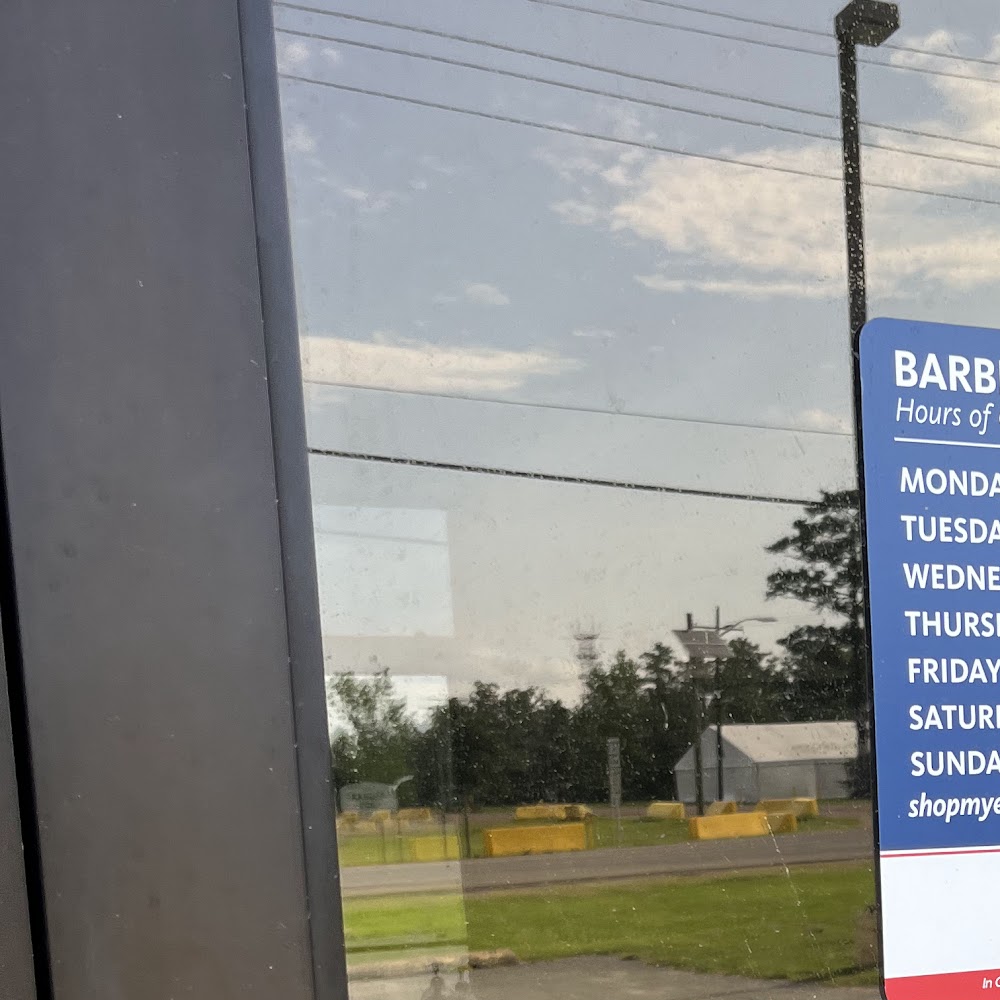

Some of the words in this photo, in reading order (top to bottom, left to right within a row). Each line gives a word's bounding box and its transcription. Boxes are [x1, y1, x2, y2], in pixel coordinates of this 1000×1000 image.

[896, 397, 961, 427] Hours
[969, 403, 994, 435] of
[982, 977, 992, 989] In
